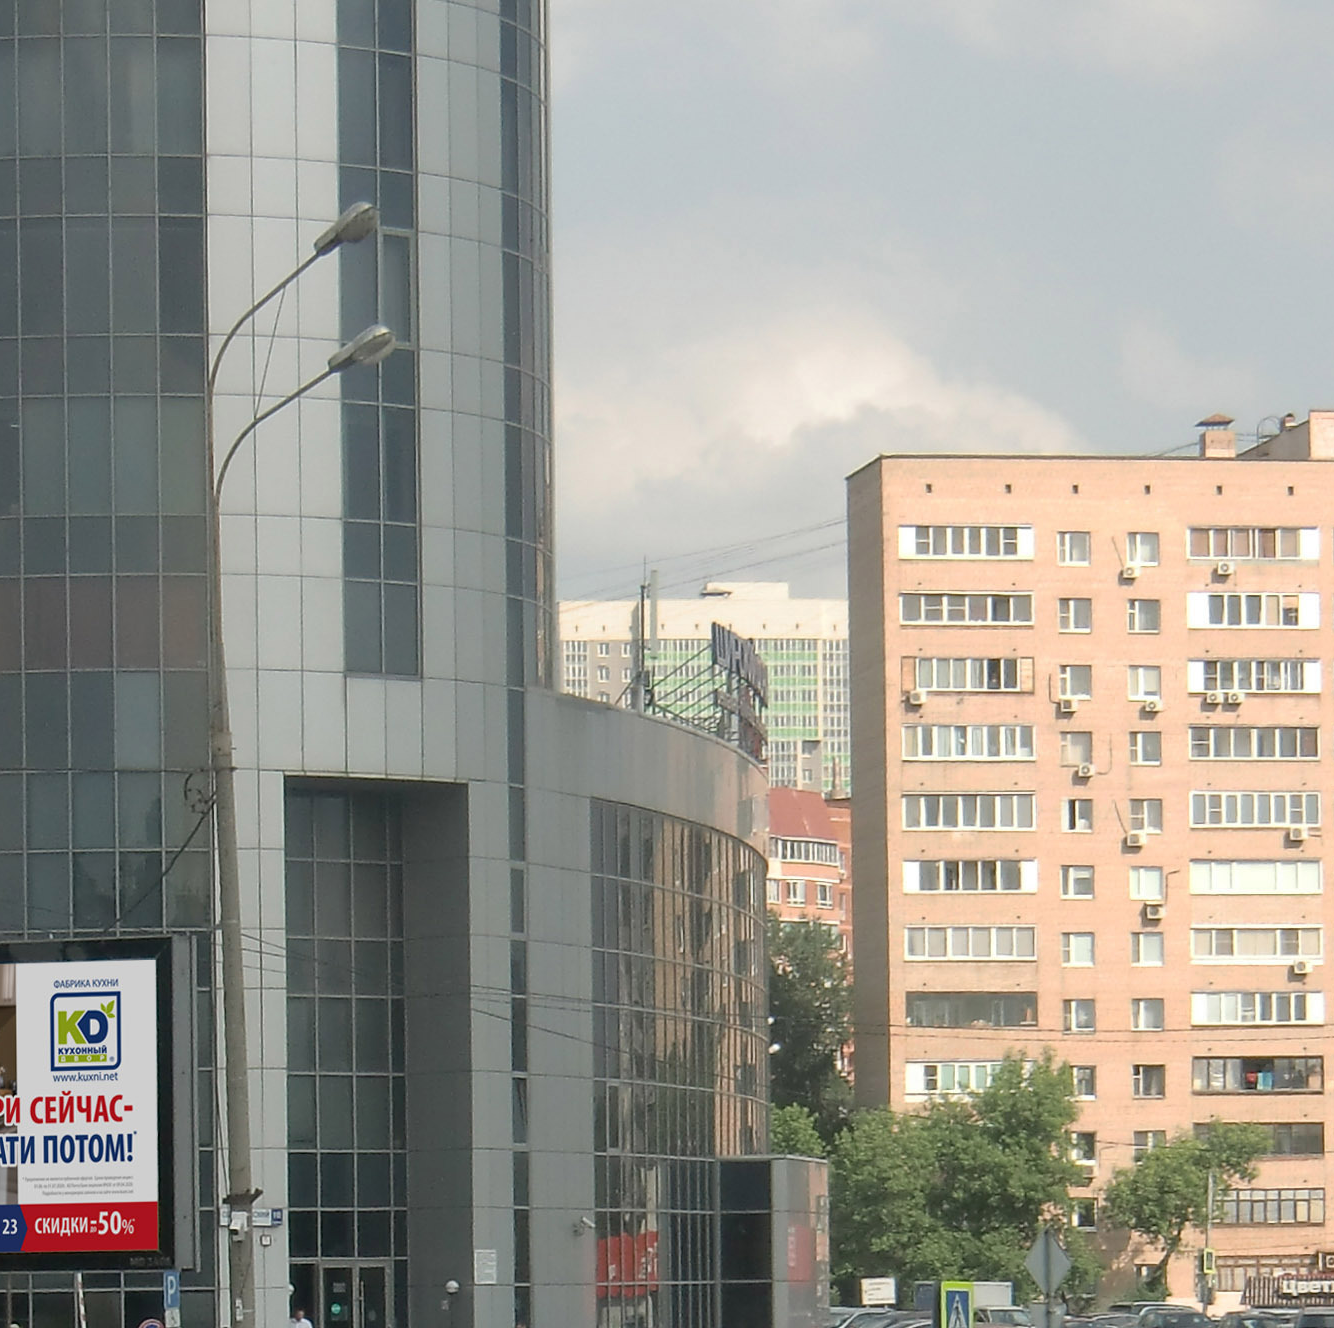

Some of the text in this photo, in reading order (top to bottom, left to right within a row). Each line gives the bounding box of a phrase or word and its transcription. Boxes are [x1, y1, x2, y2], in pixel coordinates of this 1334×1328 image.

[53, 978, 119, 989] ФАБРИКА КУХНИ
[58, 1045, 108, 1055] КУХОННЫЙ
[53, 1072, 119, 1083] www.kuxni.net
[2, 1218, 18, 1235] 23
